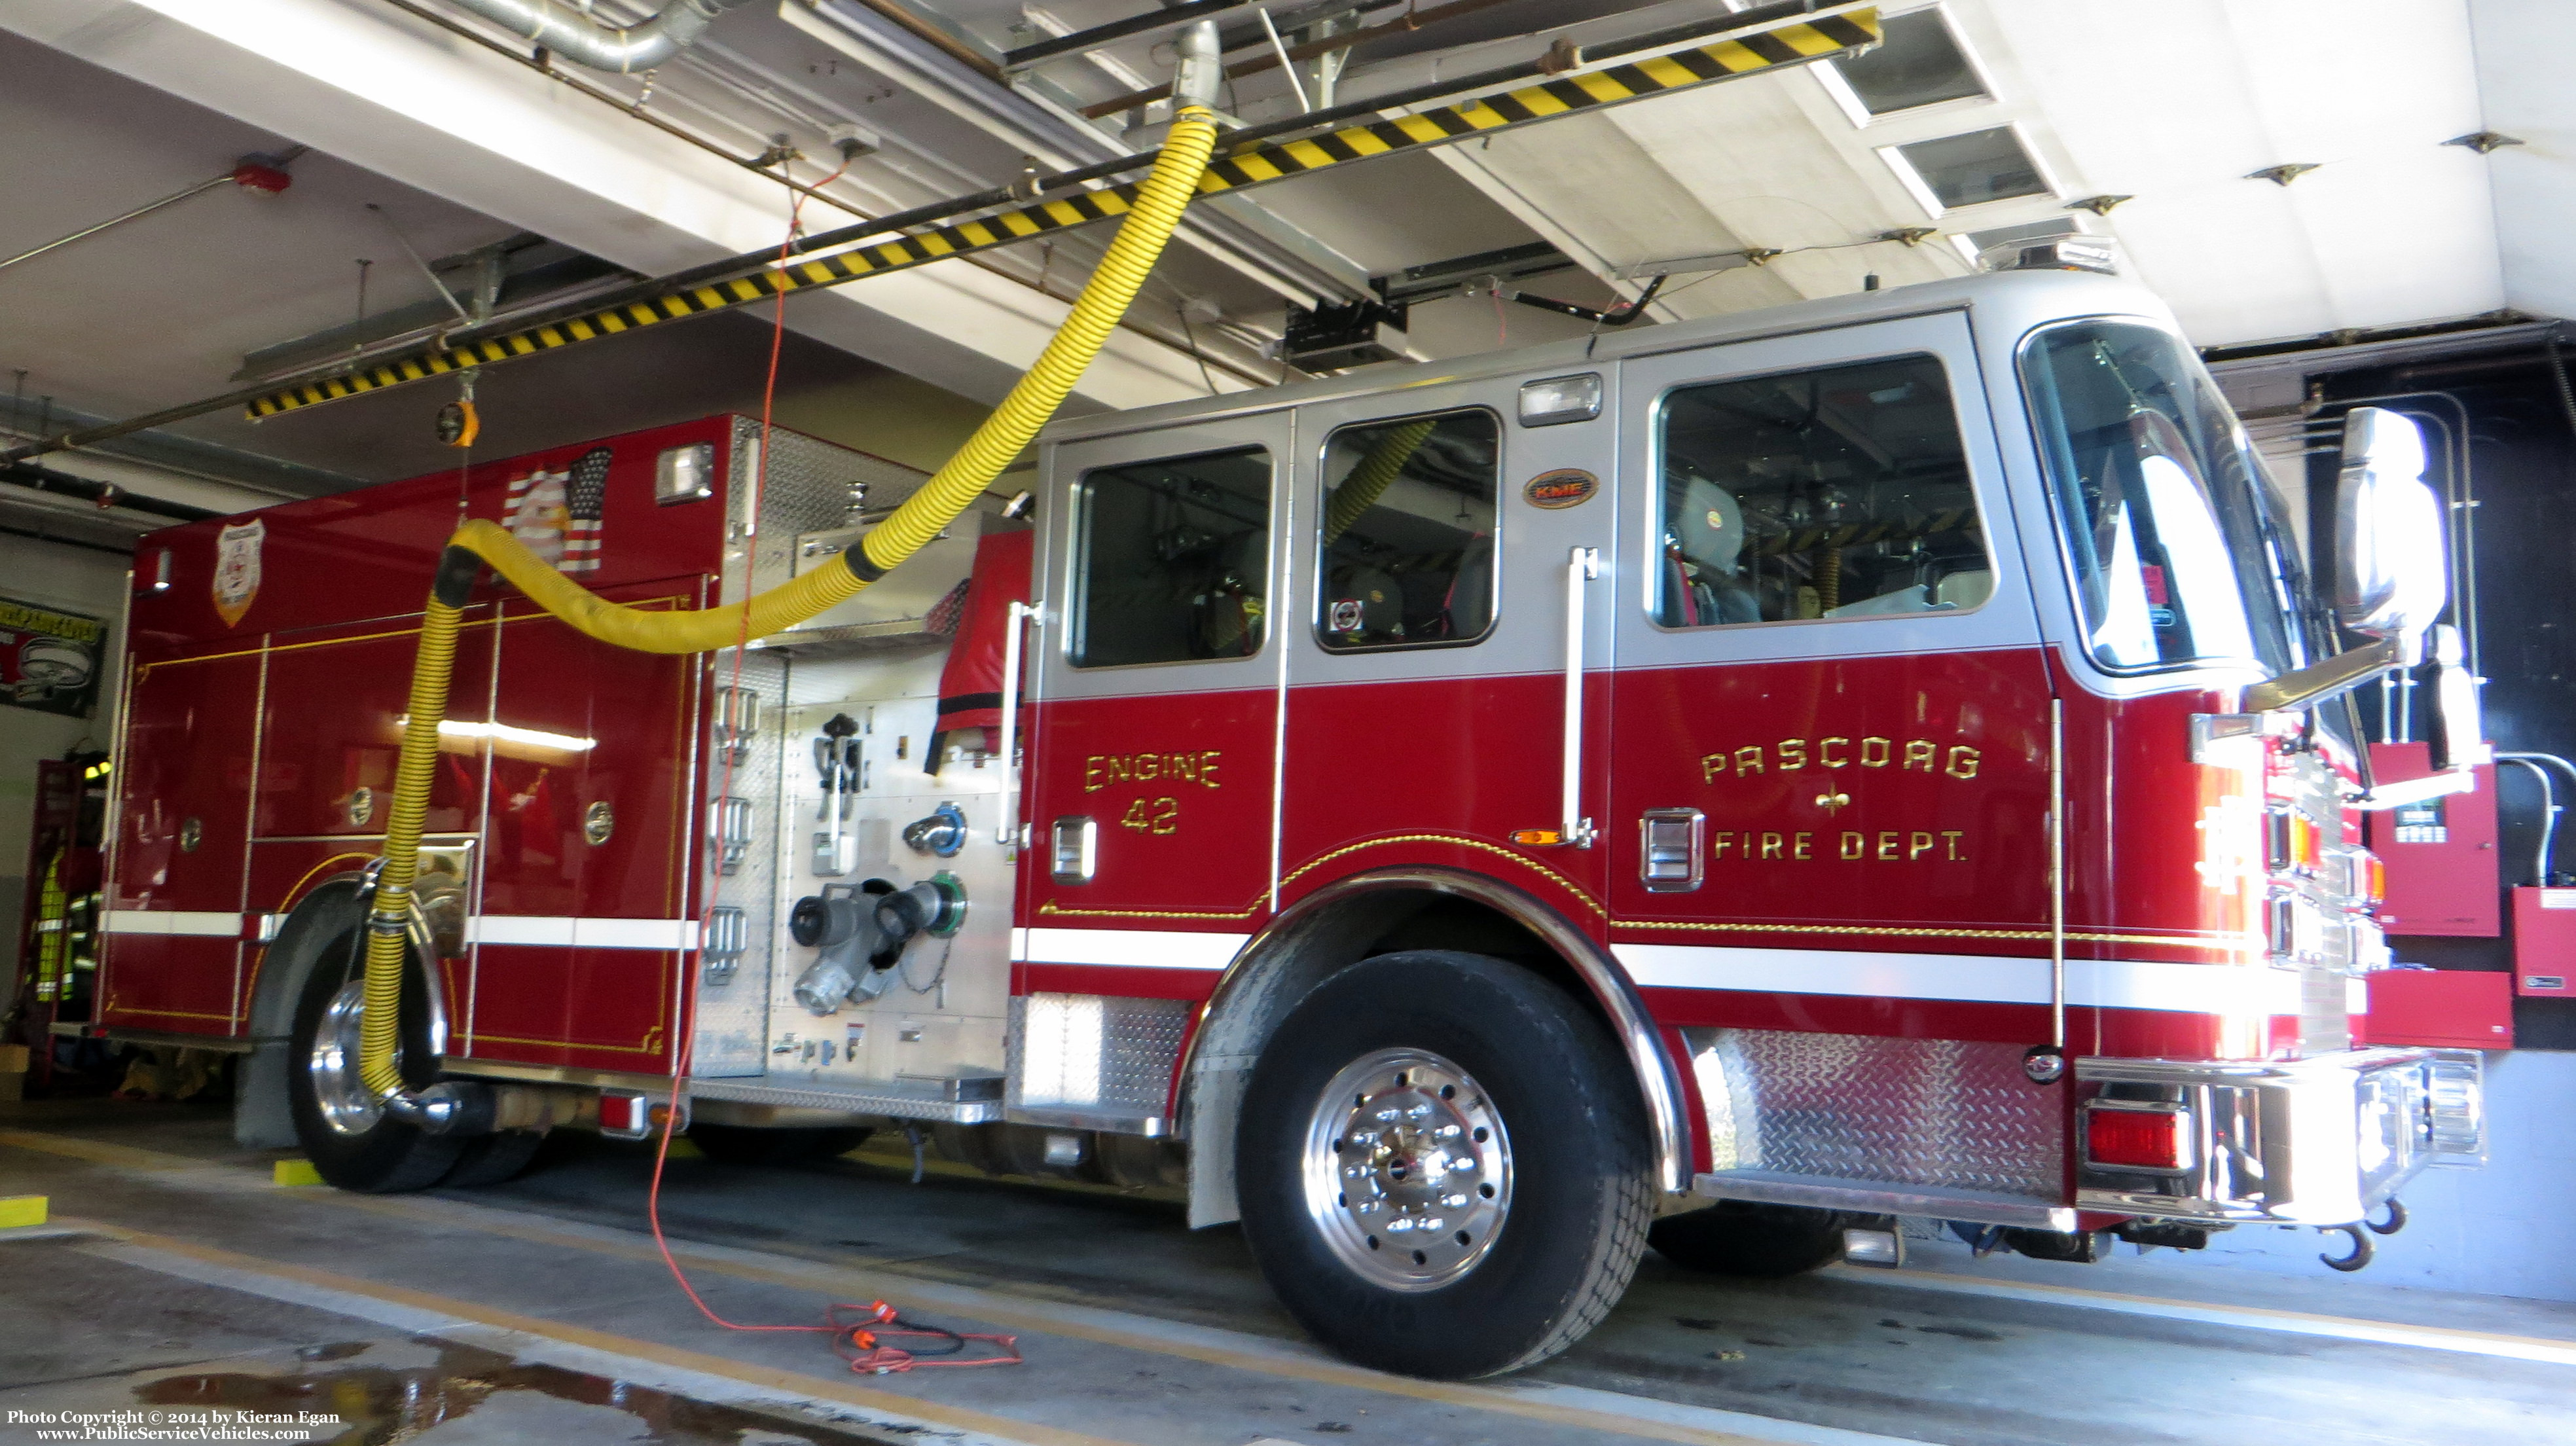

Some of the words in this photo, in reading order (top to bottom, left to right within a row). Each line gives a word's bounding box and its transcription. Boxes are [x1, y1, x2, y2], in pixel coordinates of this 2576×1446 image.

[1084, 750, 1222, 793] ENGINE
[1700, 736, 1982, 785] PASCOAG
[1120, 796, 1178, 835] 42
[1714, 831, 1813, 861] FIRE
[1840, 831, 1968, 862] DEPT.
